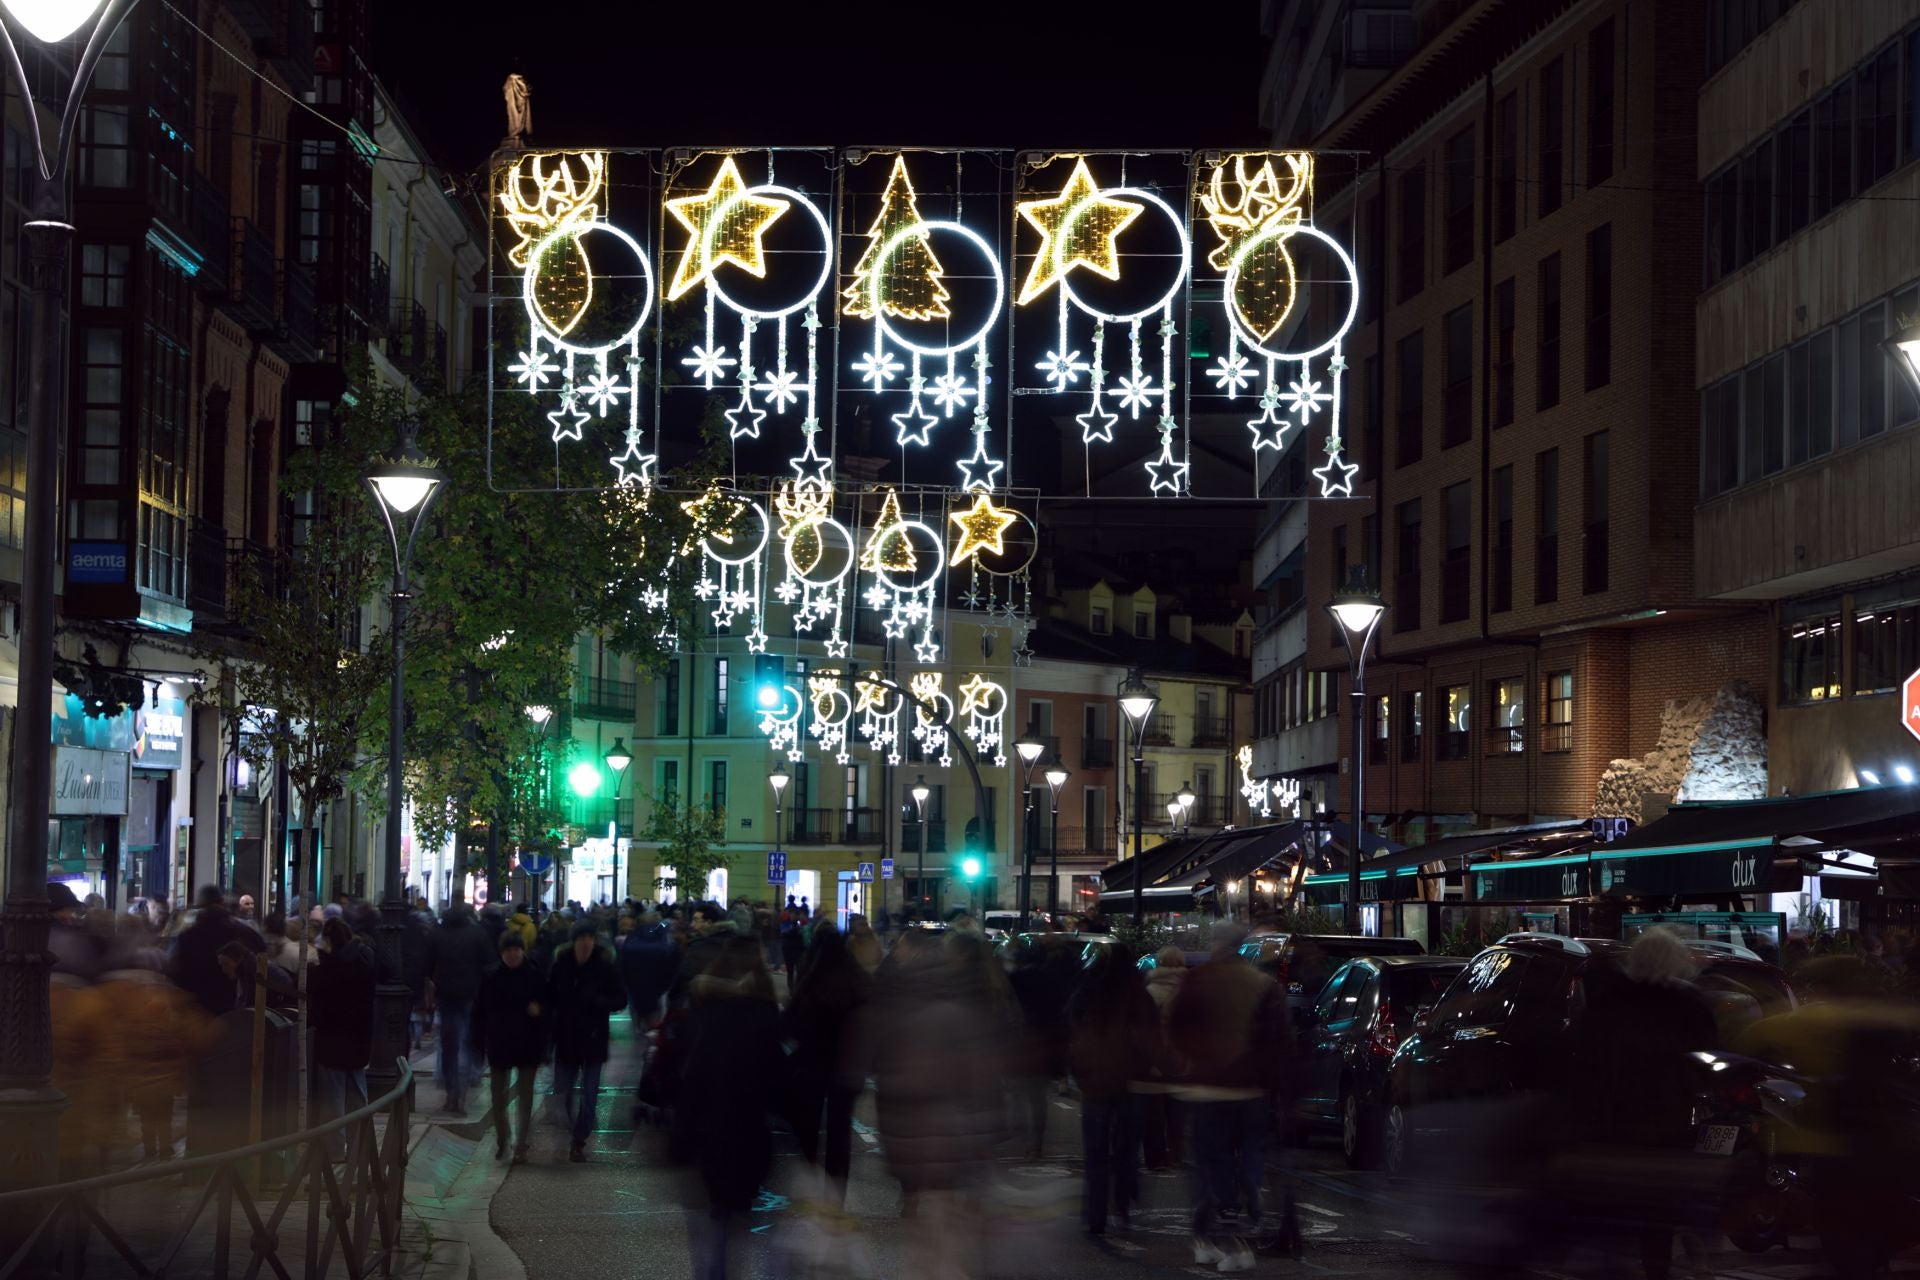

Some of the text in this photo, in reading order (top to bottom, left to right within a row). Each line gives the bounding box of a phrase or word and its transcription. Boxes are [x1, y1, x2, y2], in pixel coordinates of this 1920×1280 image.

[72, 554, 127, 569] aemta
[56, 760, 101, 800] Luisan
[1561, 865, 1579, 896] dux
[1732, 850, 1756, 888] dux
